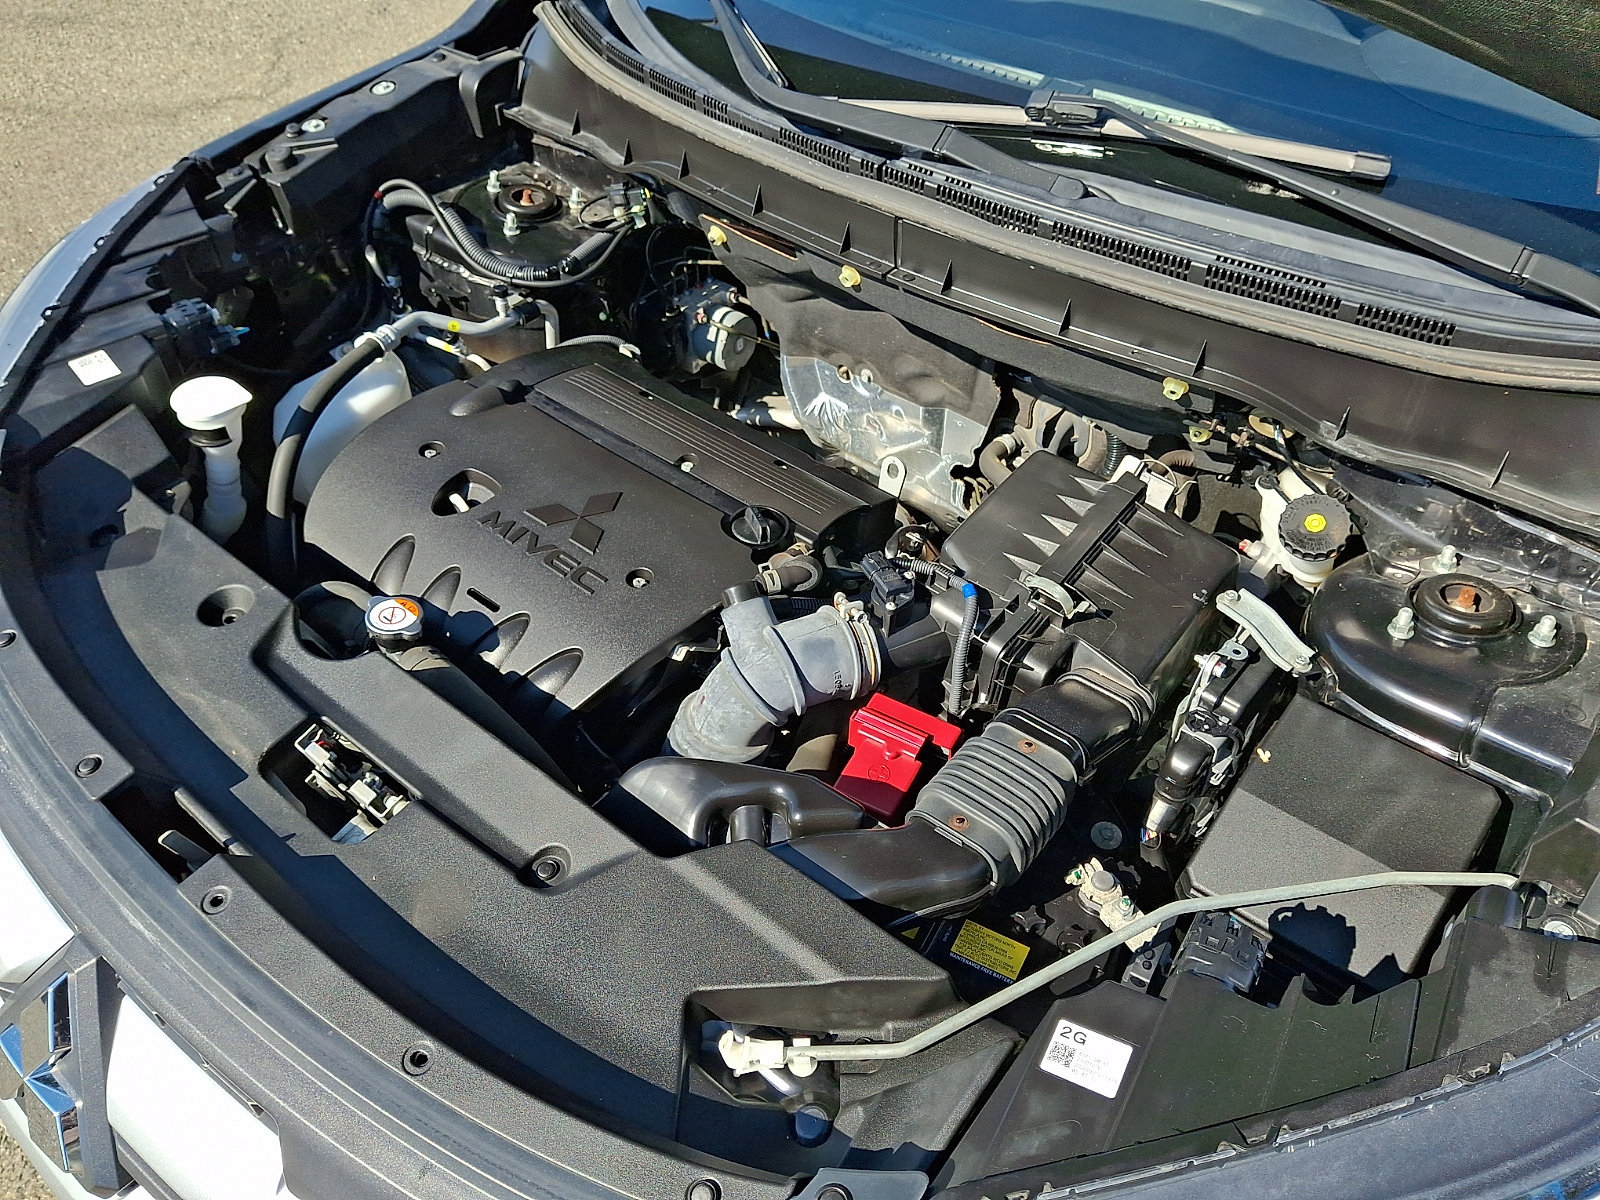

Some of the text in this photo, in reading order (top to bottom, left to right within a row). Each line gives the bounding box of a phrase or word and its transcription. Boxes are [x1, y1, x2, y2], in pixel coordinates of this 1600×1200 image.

[477, 510, 609, 595] MIVEC
[948, 951, 980, 969] MAINTENANCE
[980, 966, 993, 975] FREE
[992, 972, 1013, 984] BATTERY
[1060, 1026, 1087, 1046] 2G
